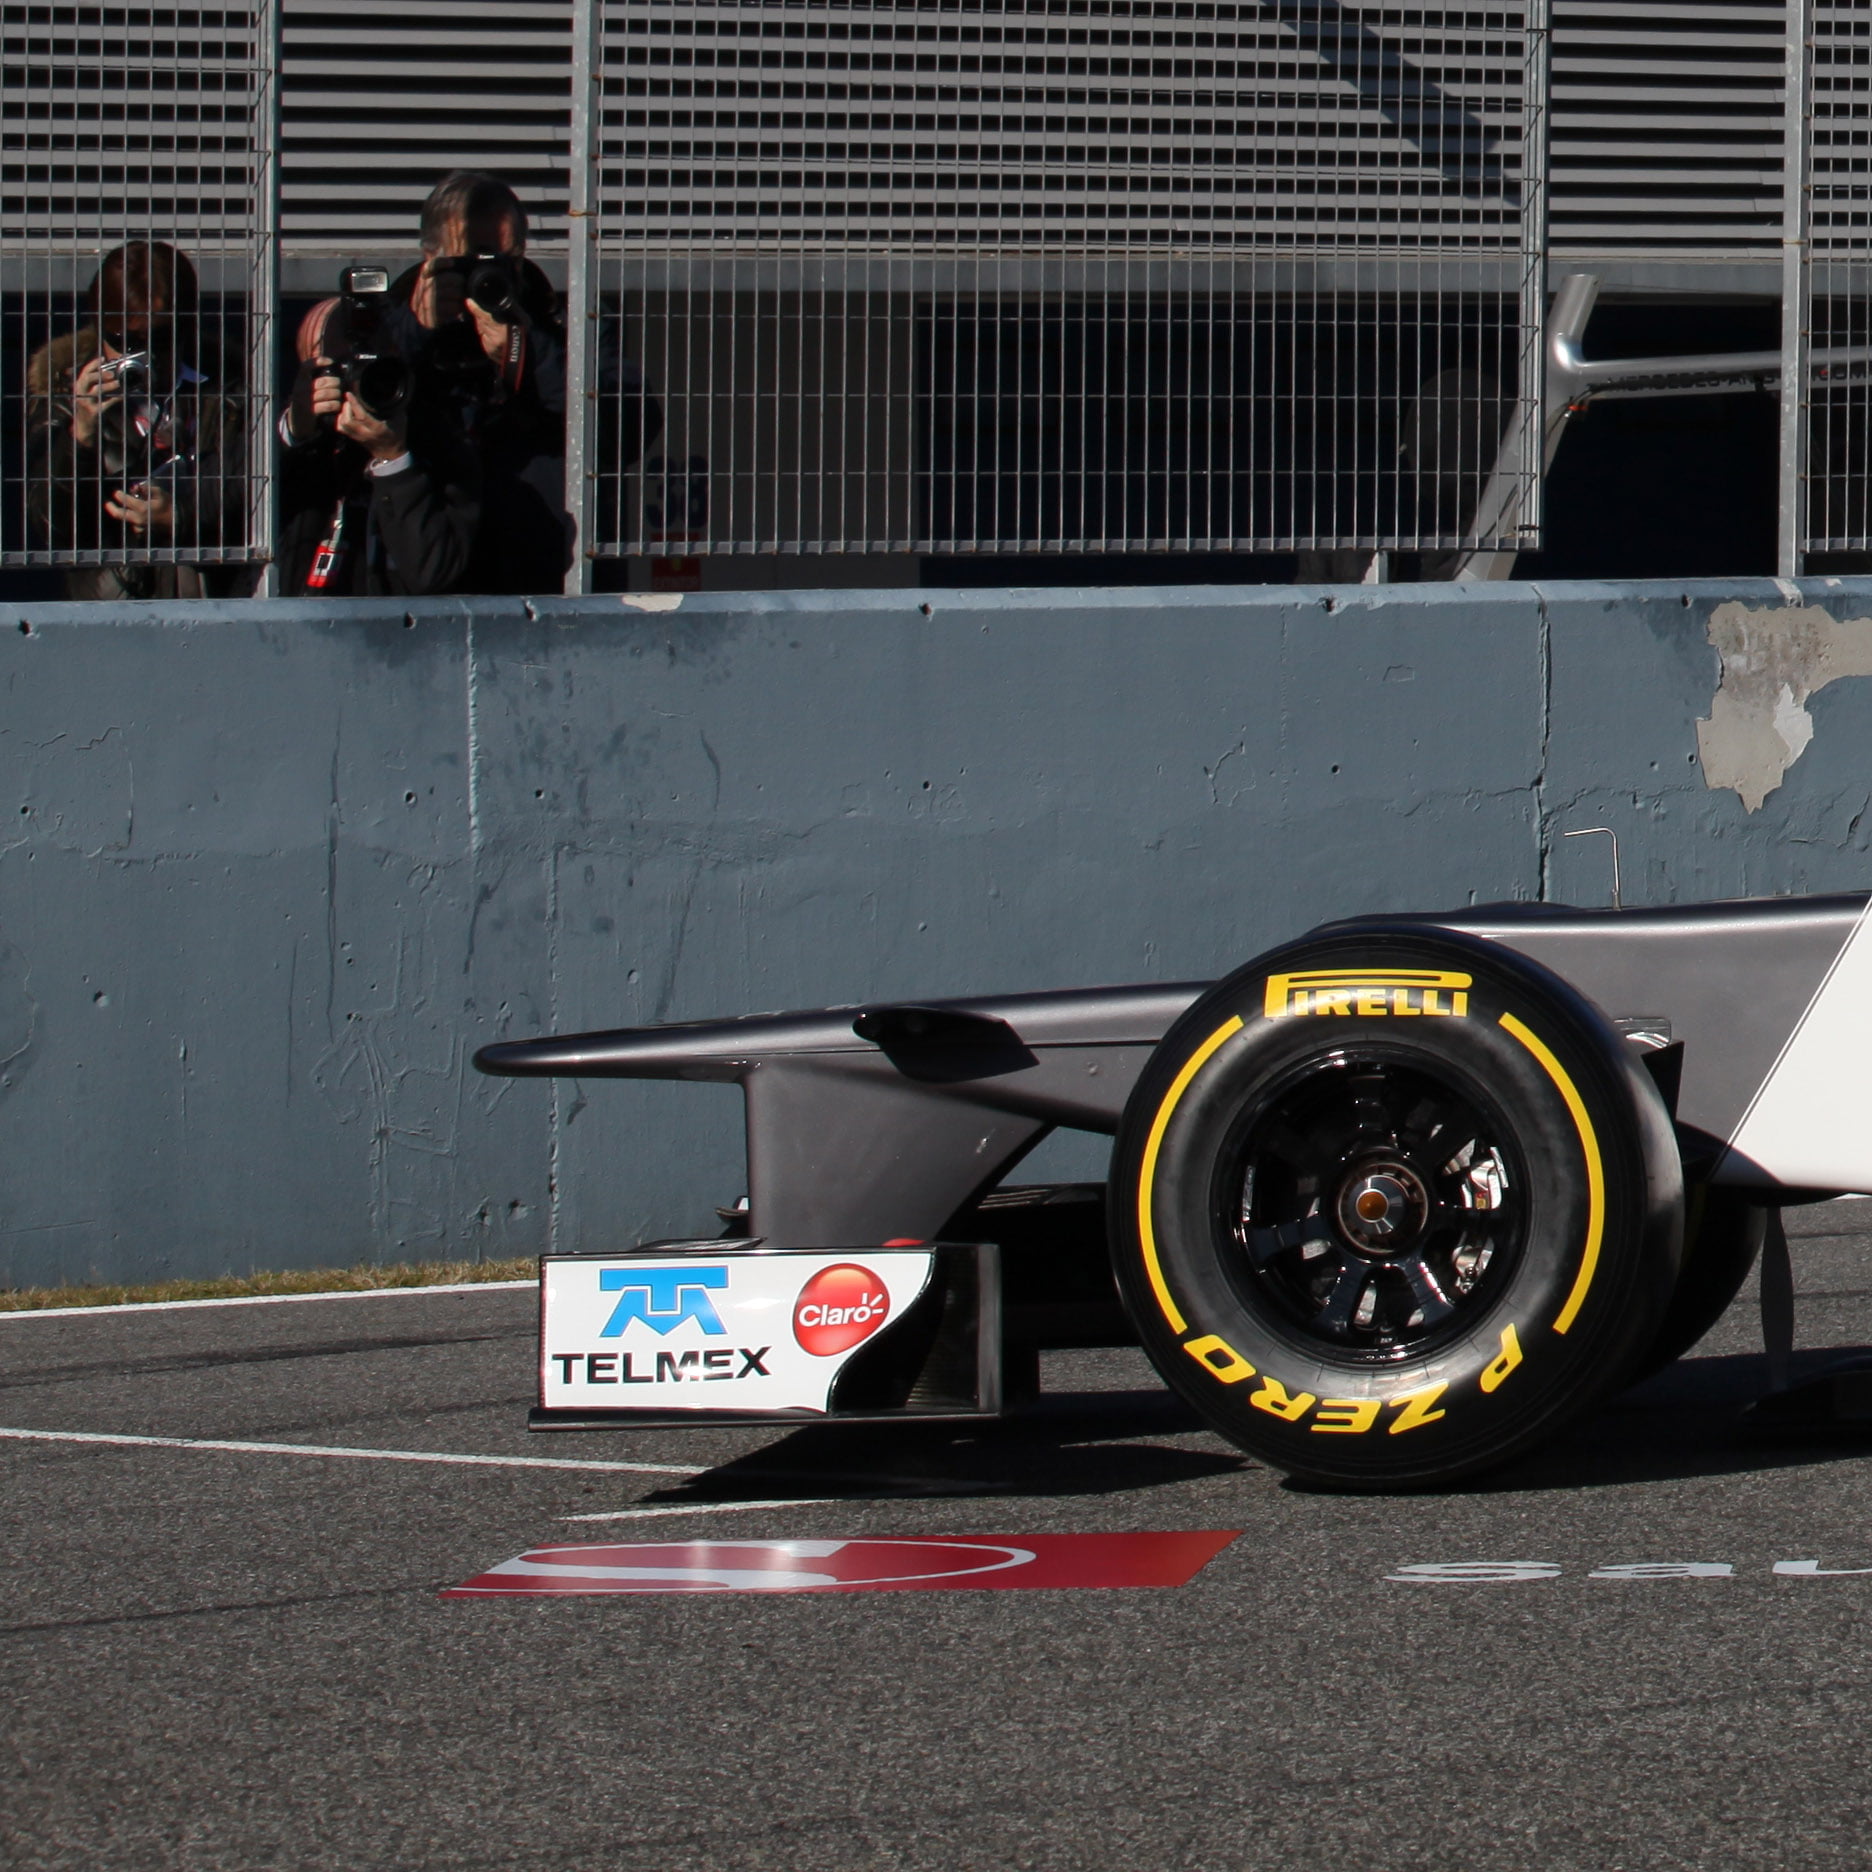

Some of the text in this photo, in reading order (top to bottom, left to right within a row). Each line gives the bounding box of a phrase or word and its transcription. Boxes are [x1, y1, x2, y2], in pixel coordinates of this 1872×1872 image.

[1264, 968, 1473, 1018] PIRELLI
[799, 1303, 873, 1328] Claro
[552, 1346, 772, 1384] TELMEX
[1183, 1323, 1523, 1435] P ZERO
